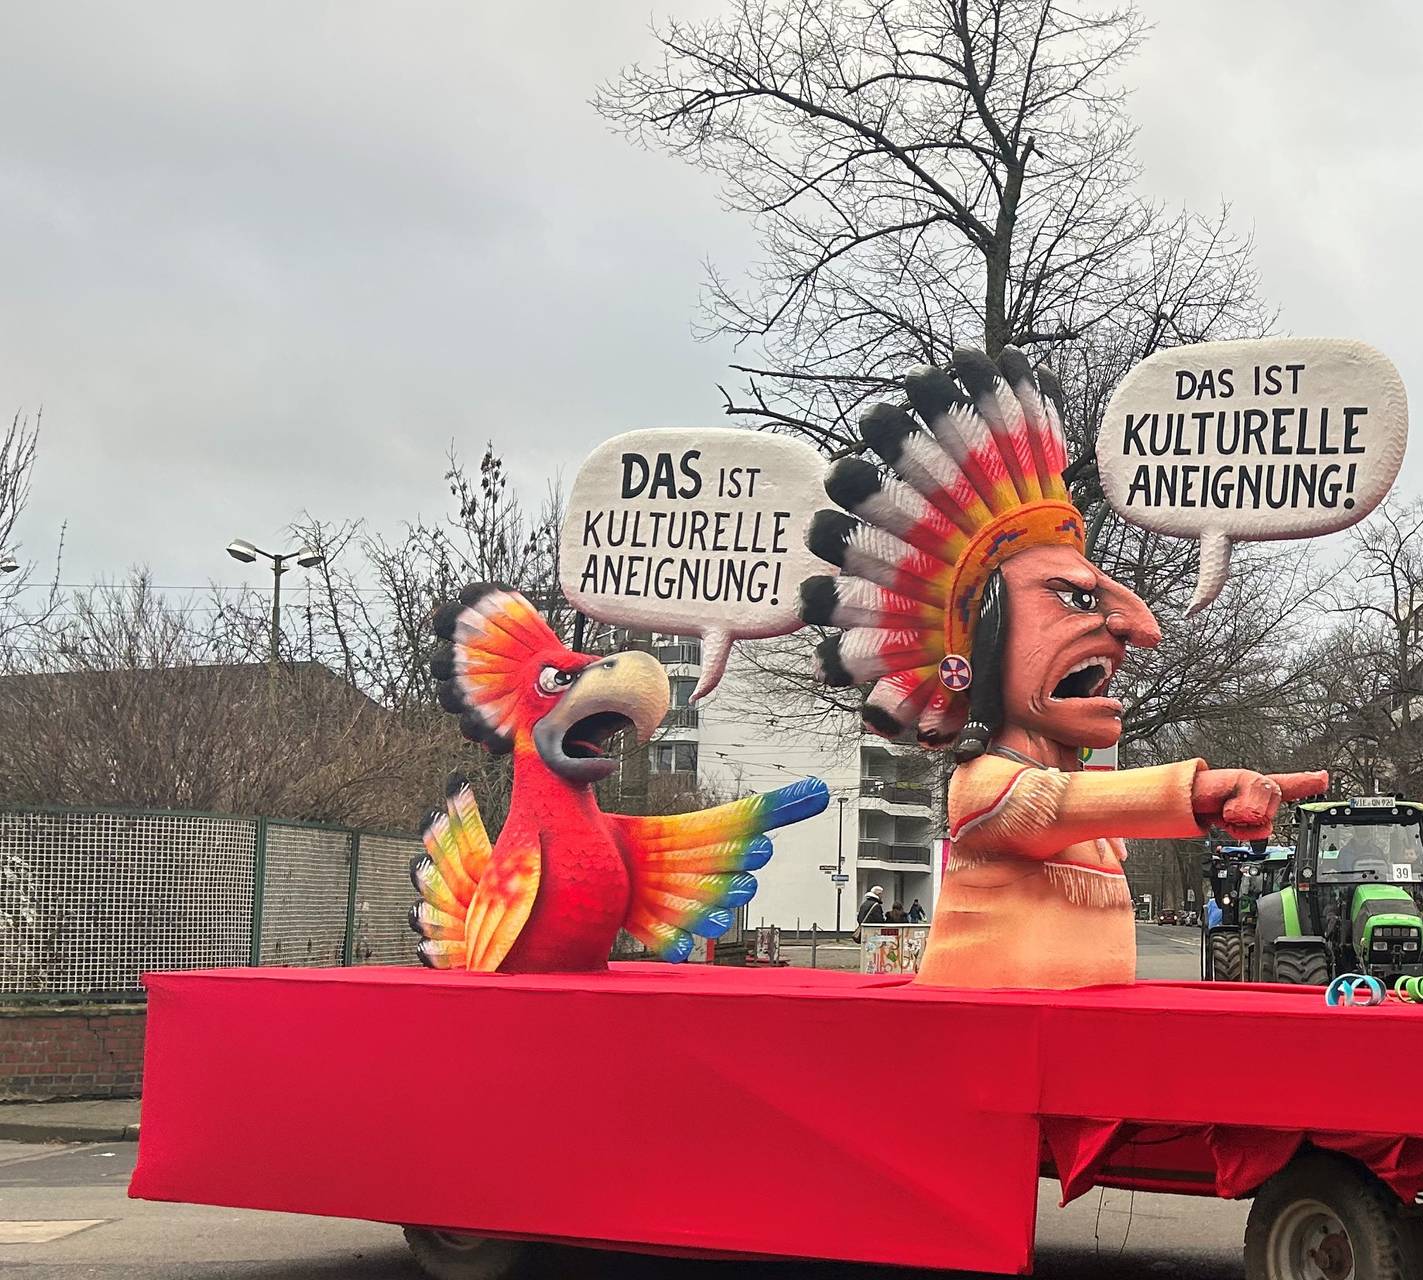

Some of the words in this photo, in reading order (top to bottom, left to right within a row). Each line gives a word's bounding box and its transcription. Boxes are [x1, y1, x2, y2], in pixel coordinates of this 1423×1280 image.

[1175, 367, 1234, 400] DAS
[1254, 364, 1305, 395] IST
[1123, 407, 1368, 456] KULTURELLE
[621, 450, 702, 499] DAS
[718, 467, 761, 498] IST
[1126, 463, 1357, 509] ANEIGNUNG!
[583, 510, 790, 553] KULTURELLE
[580, 554, 781, 606] ANEIGNUNG!
[1396, 867, 1409, 879] 39
